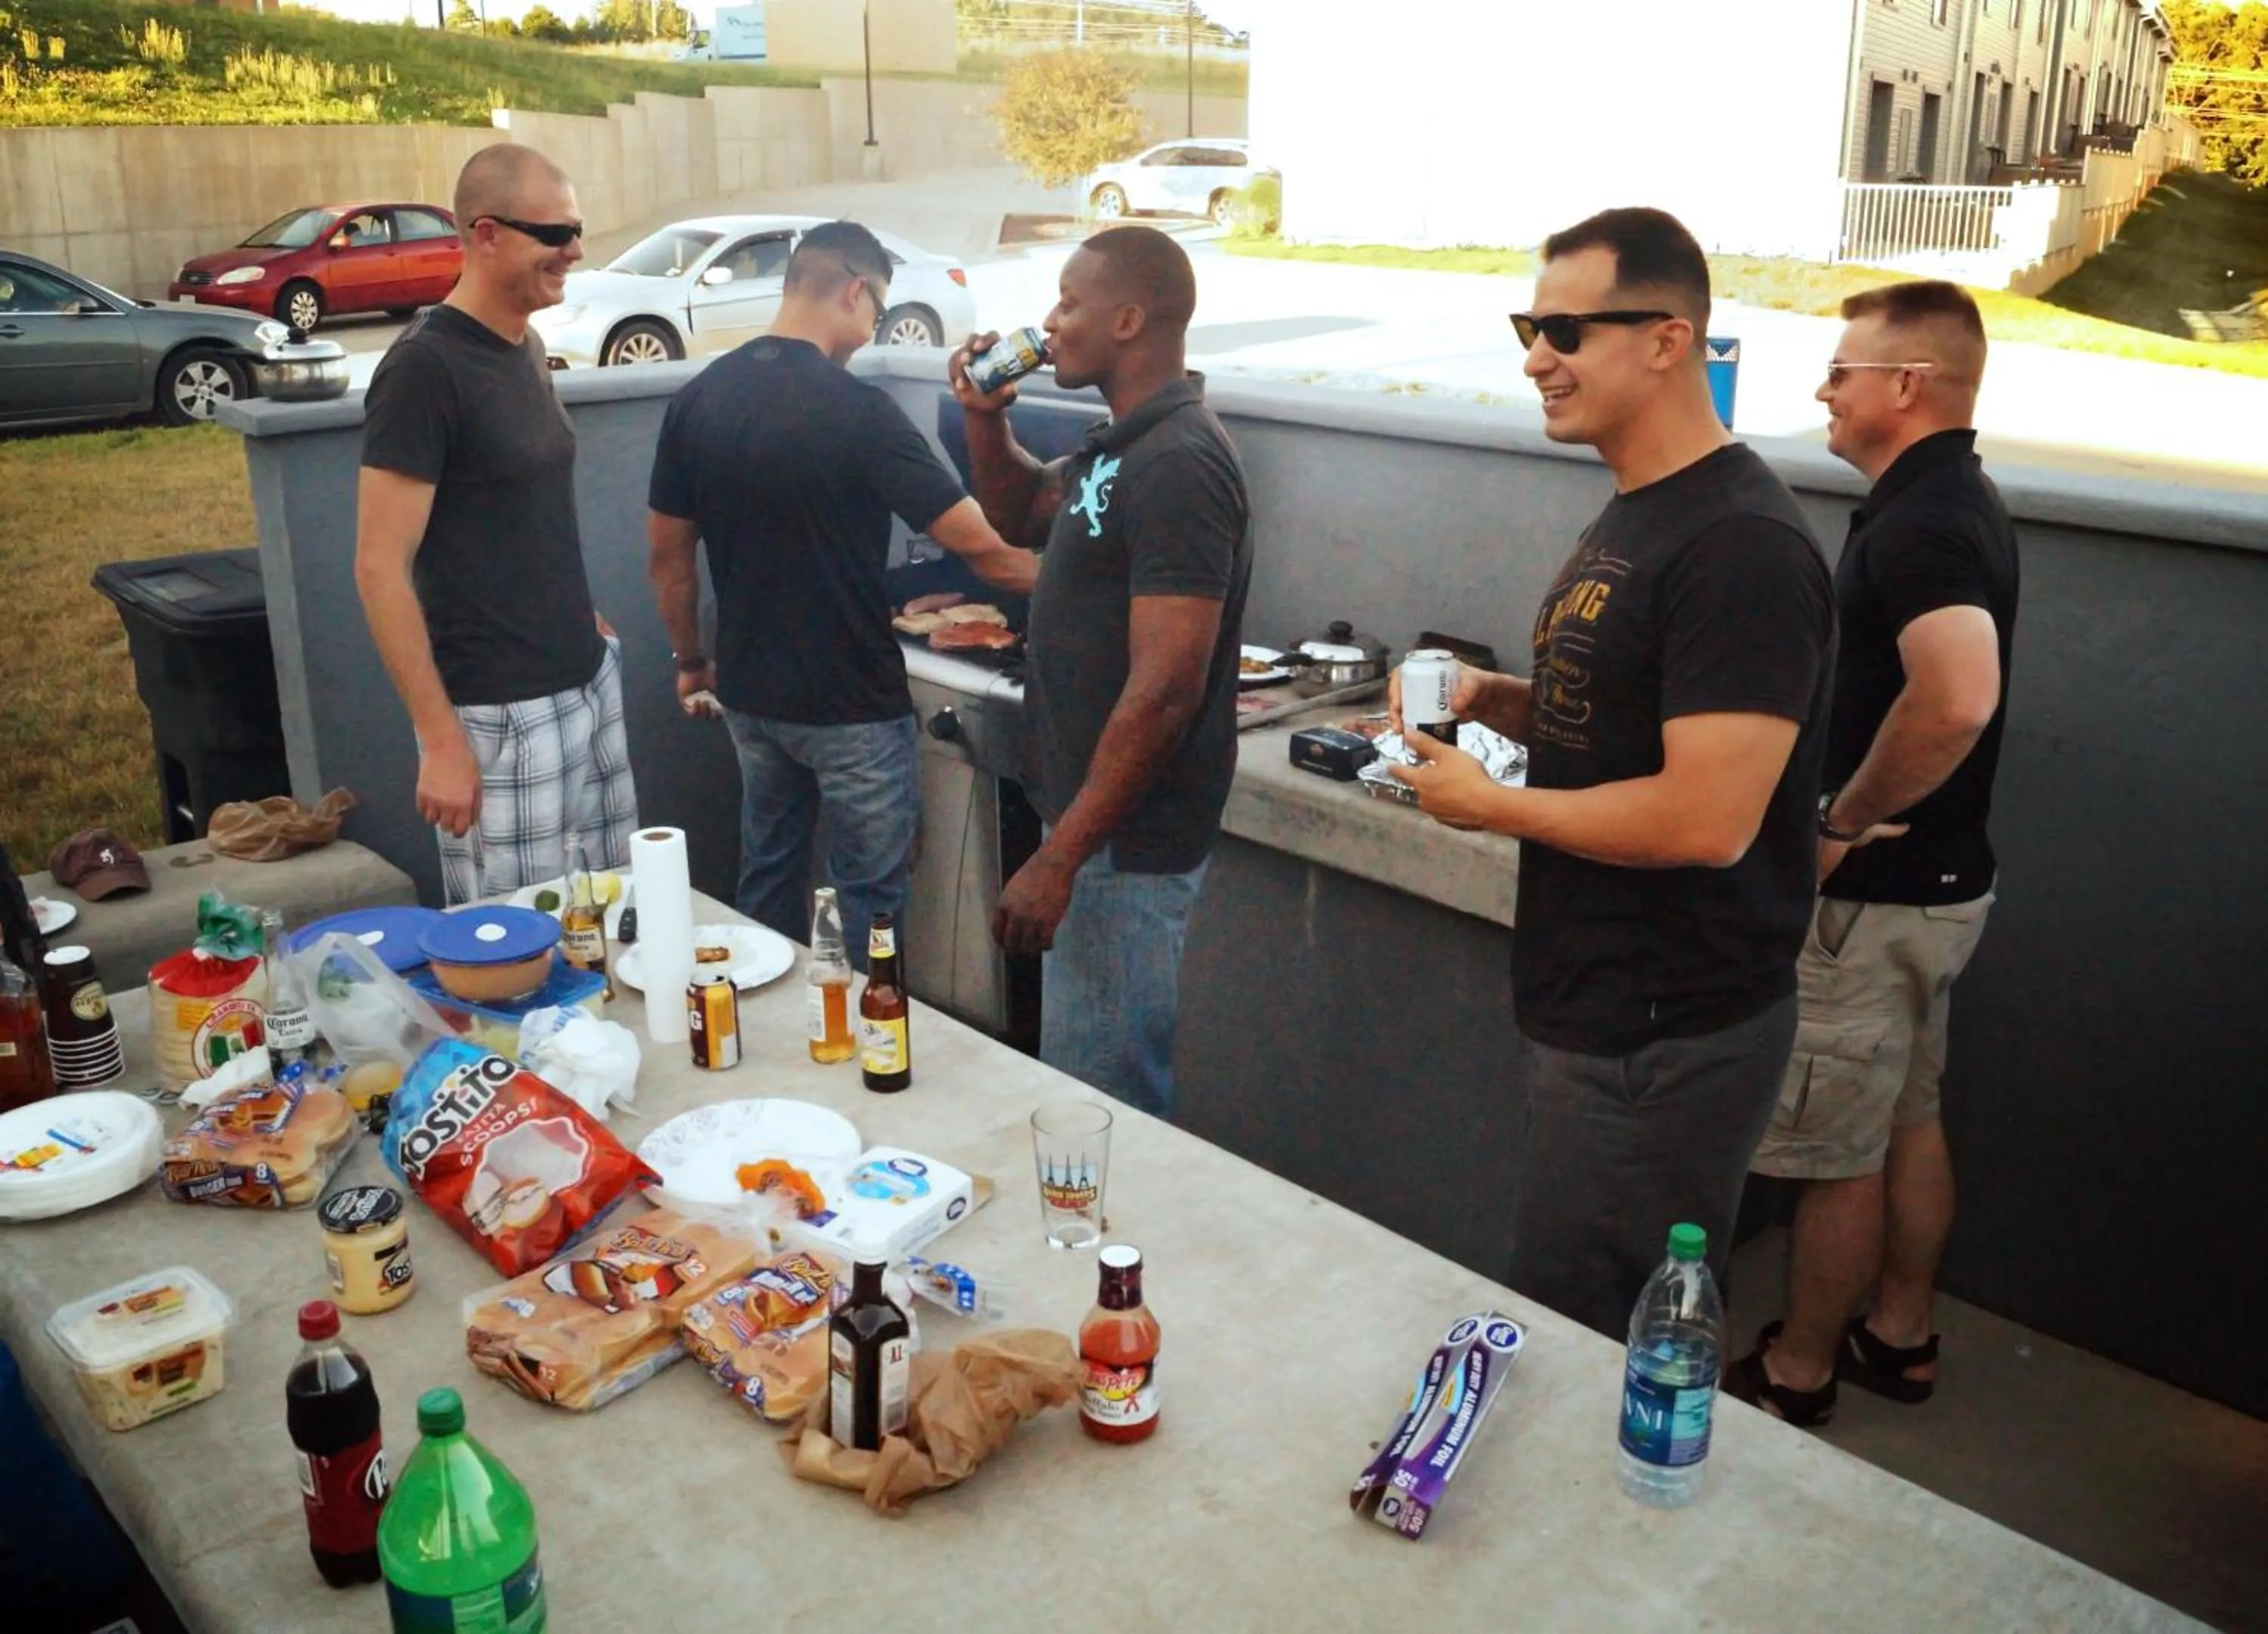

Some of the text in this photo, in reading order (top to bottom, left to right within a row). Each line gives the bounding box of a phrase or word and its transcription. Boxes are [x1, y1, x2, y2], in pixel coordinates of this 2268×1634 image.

[267, 1013, 308, 1030] Corona
[460, 1097, 538, 1166] SCOOPS!
[256, 1162, 268, 1178] 8
[539, 1366, 557, 1381] 12
[1445, 1388, 1478, 1446] ALUMINUM
[1430, 1444, 1454, 1467] FOIL
